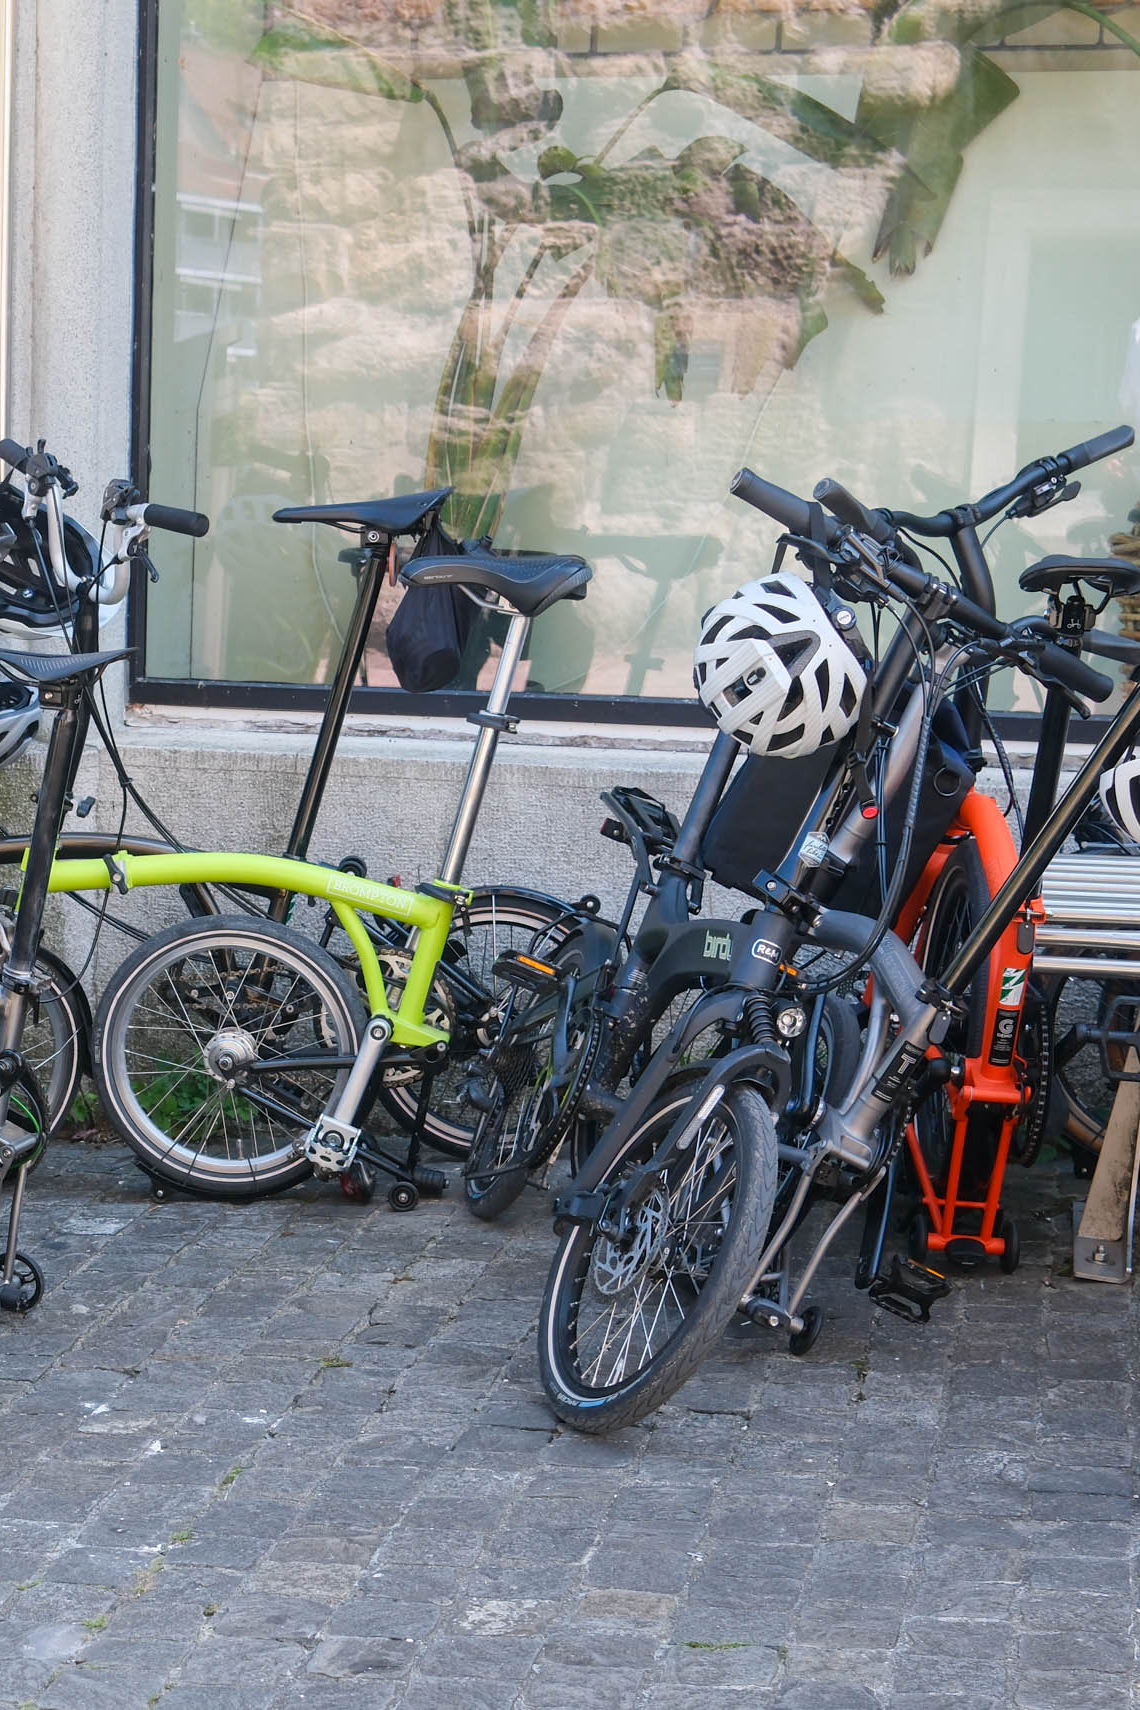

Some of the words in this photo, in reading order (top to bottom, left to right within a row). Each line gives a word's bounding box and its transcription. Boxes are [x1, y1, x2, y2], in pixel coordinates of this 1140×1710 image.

[332, 878, 409, 909] BROMPTON
[998, 1018, 1014, 1034] G
[897, 1053, 917, 1075] T
